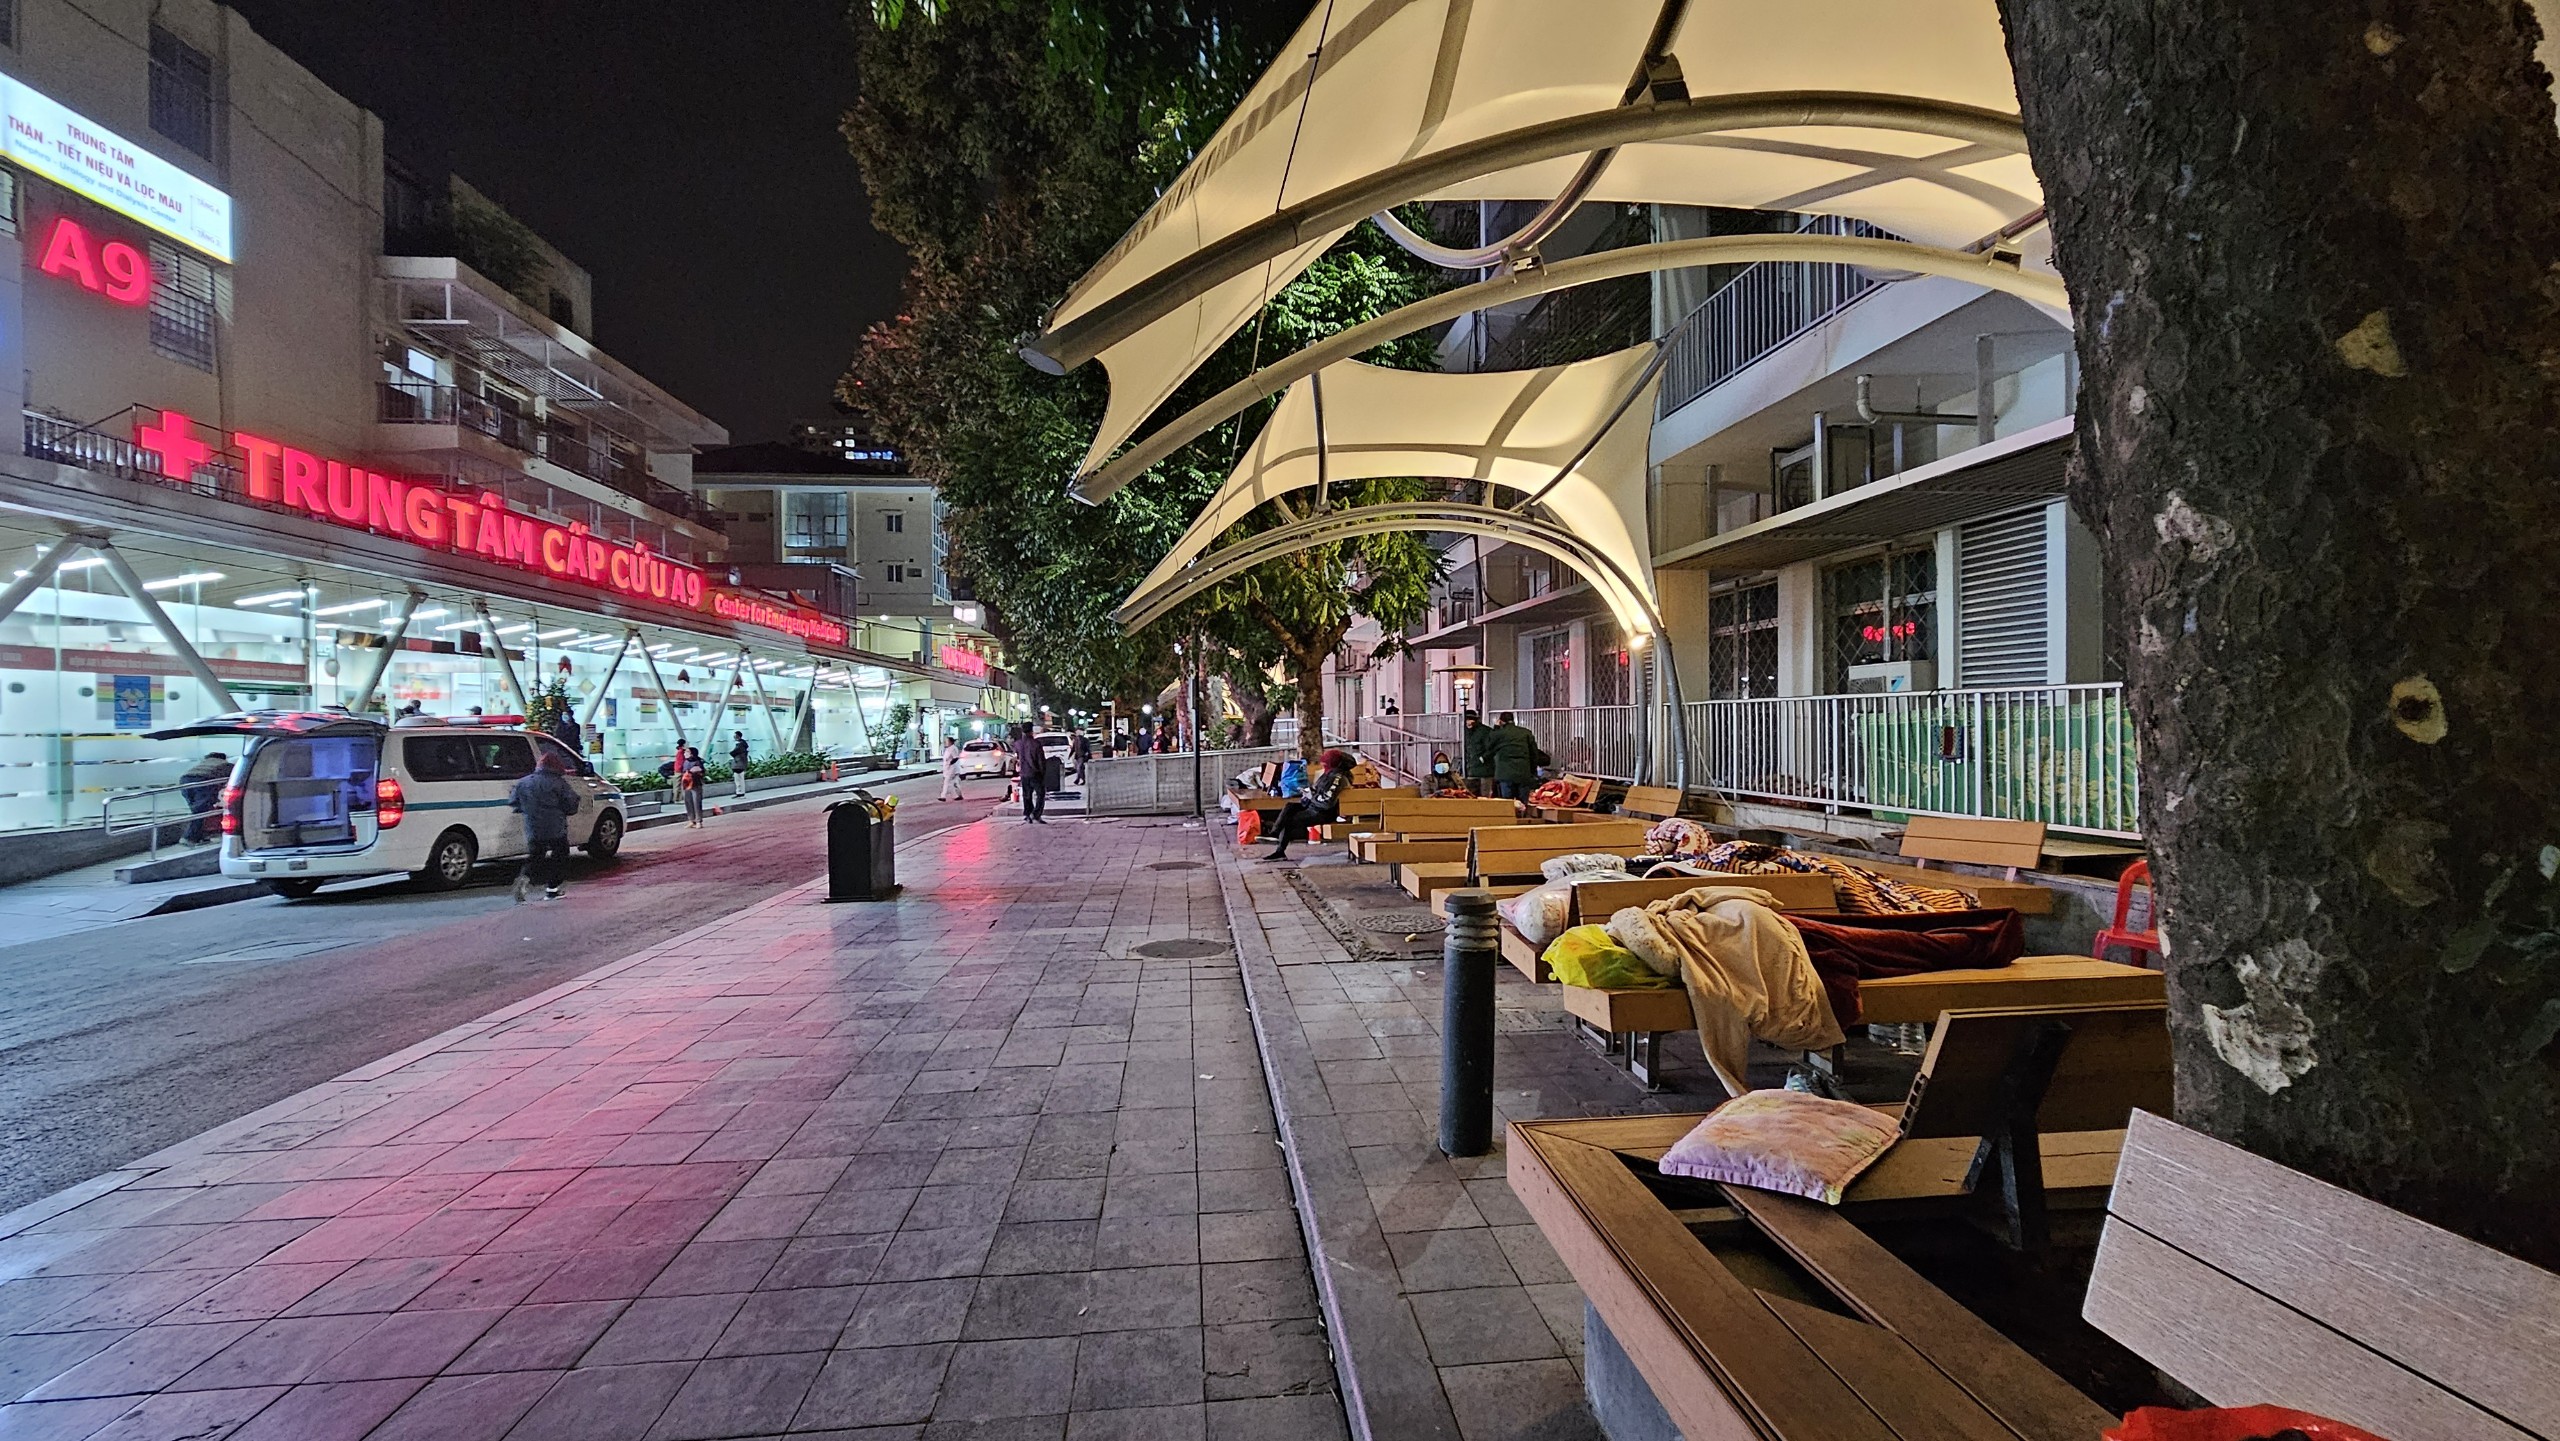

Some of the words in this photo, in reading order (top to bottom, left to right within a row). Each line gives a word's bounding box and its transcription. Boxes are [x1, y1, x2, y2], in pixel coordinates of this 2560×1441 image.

[56, 139, 82, 163] TIẾT
[85, 155, 114, 178] NIỆU
[117, 170, 131, 188] VÀ
[134, 180, 155, 200] LỌC
[158, 192, 182, 213] MÁU
[66, 123, 107, 154] TRUNG
[110, 146, 135, 169] TÂM
[41, 217, 147, 302] A9
[234, 432, 438, 539] TRUNG
[446, 491, 534, 565] TÂM
[542, 521, 606, 581] CẤP
[611, 541, 667, 598] CỨU
[670, 567, 700, 607] A9
[714, 593, 750, 620] Center
[751, 602, 766, 623] for
[766, 607, 810, 637] Emergency
[810, 619, 843, 641] Medicine
